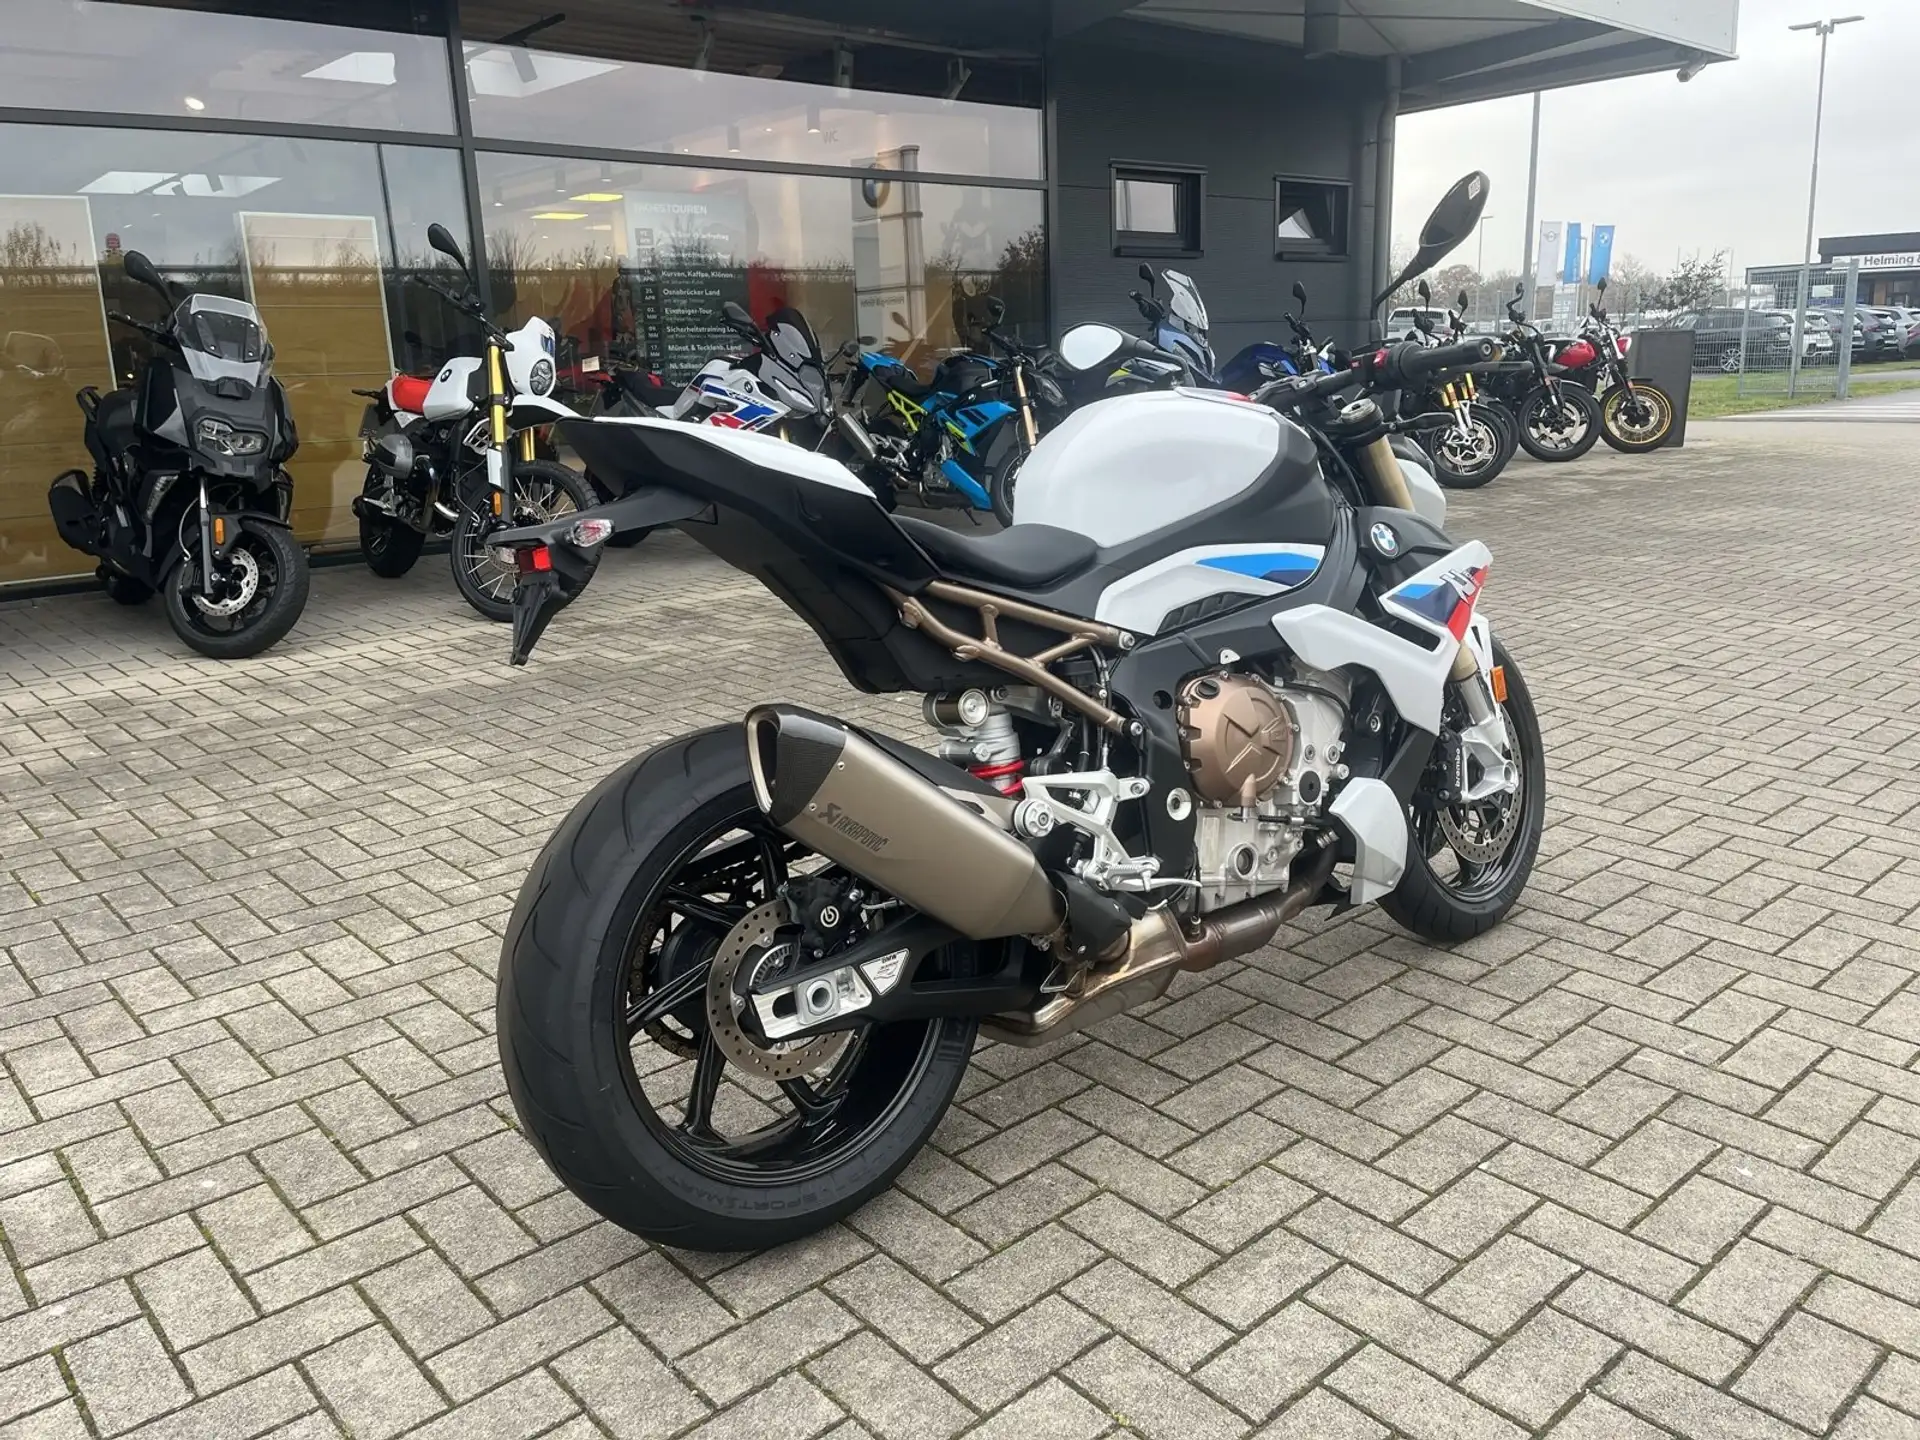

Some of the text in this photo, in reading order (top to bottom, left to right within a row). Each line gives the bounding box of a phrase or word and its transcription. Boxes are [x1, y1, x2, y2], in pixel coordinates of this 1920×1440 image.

[823, 130, 839, 143] WC
[1863, 254, 1914, 266] Helming
[662, 288, 721, 296] Osnabrücker Land
[666, 325, 726, 334] Sicherheitstraining
